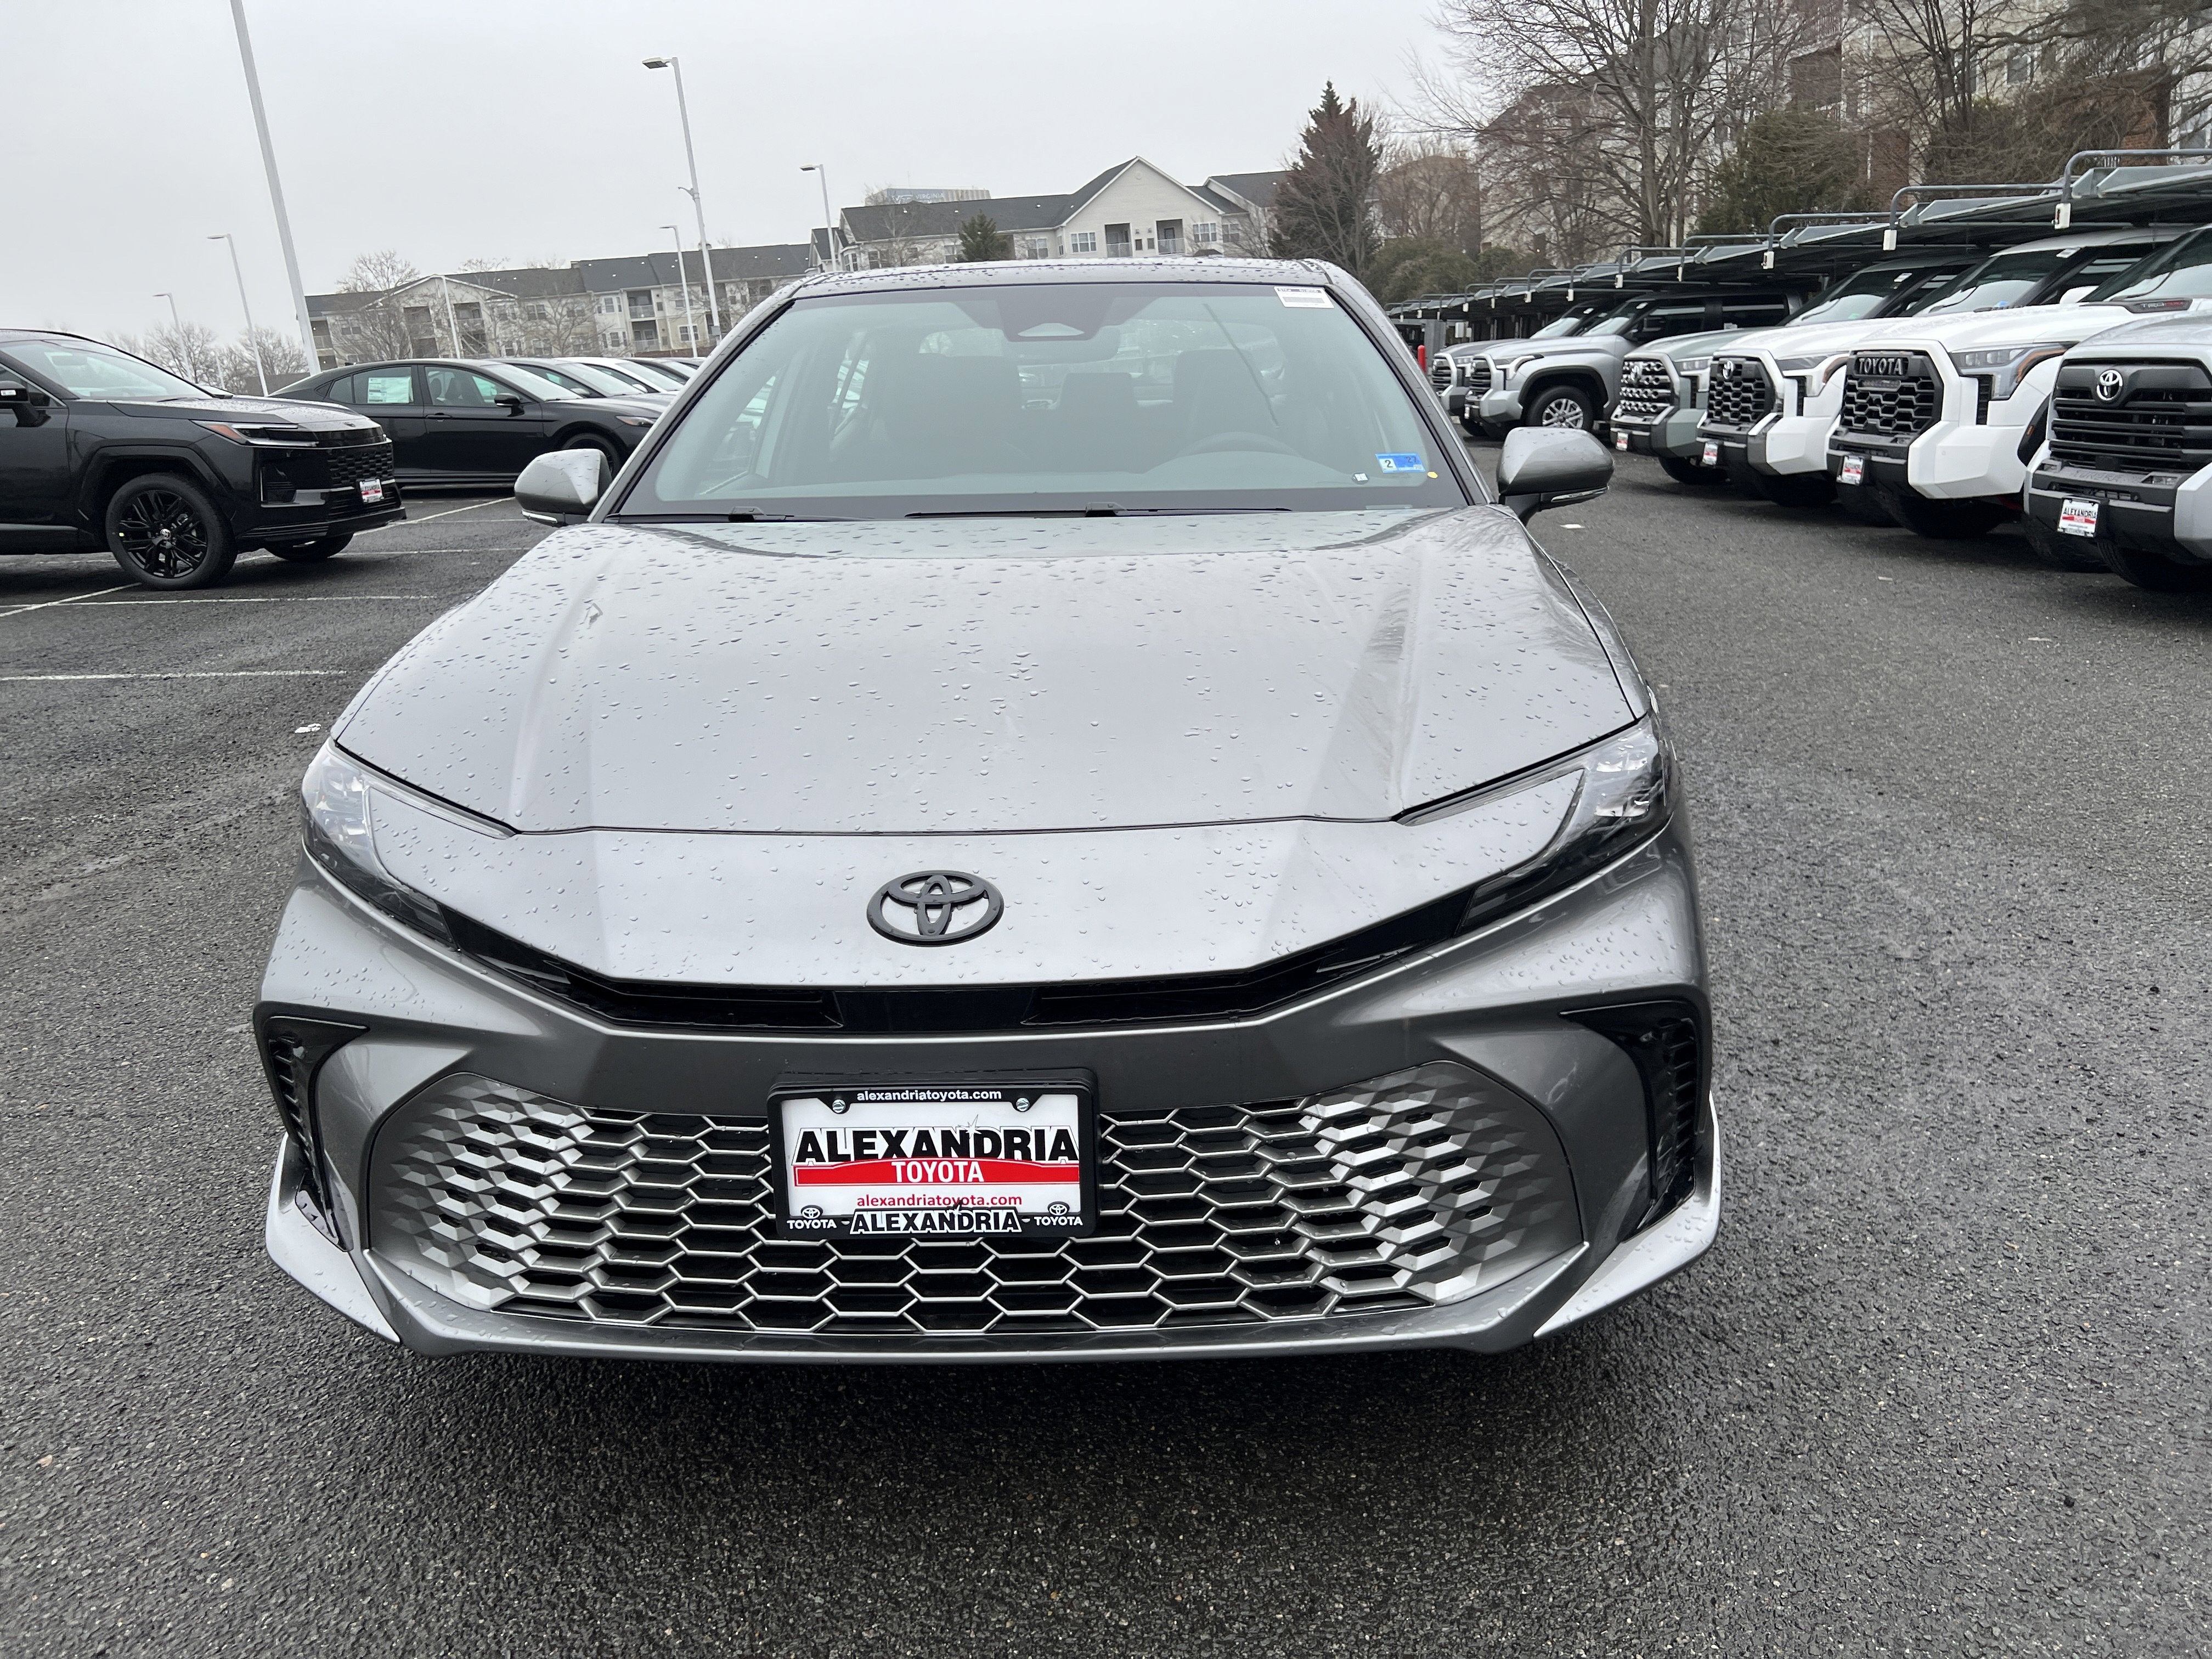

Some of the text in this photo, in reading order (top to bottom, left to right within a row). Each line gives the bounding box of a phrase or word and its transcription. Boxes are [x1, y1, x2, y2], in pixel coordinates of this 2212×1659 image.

[1859, 358, 1903, 375] TOYOTA
[857, 1089, 1002, 1102] alexandriatoyota.com
[794, 1127, 1079, 1163] ALEXANDRIA
[891, 1161, 985, 1183] TOYOTA
[857, 1194, 1022, 1206] alexandriatoyota.com
[787, 1219, 837, 1229] TOYOTA
[851, 1210, 1021, 1234] ALEXANDRIA
[1034, 1216, 1083, 1226] TOYOTA
